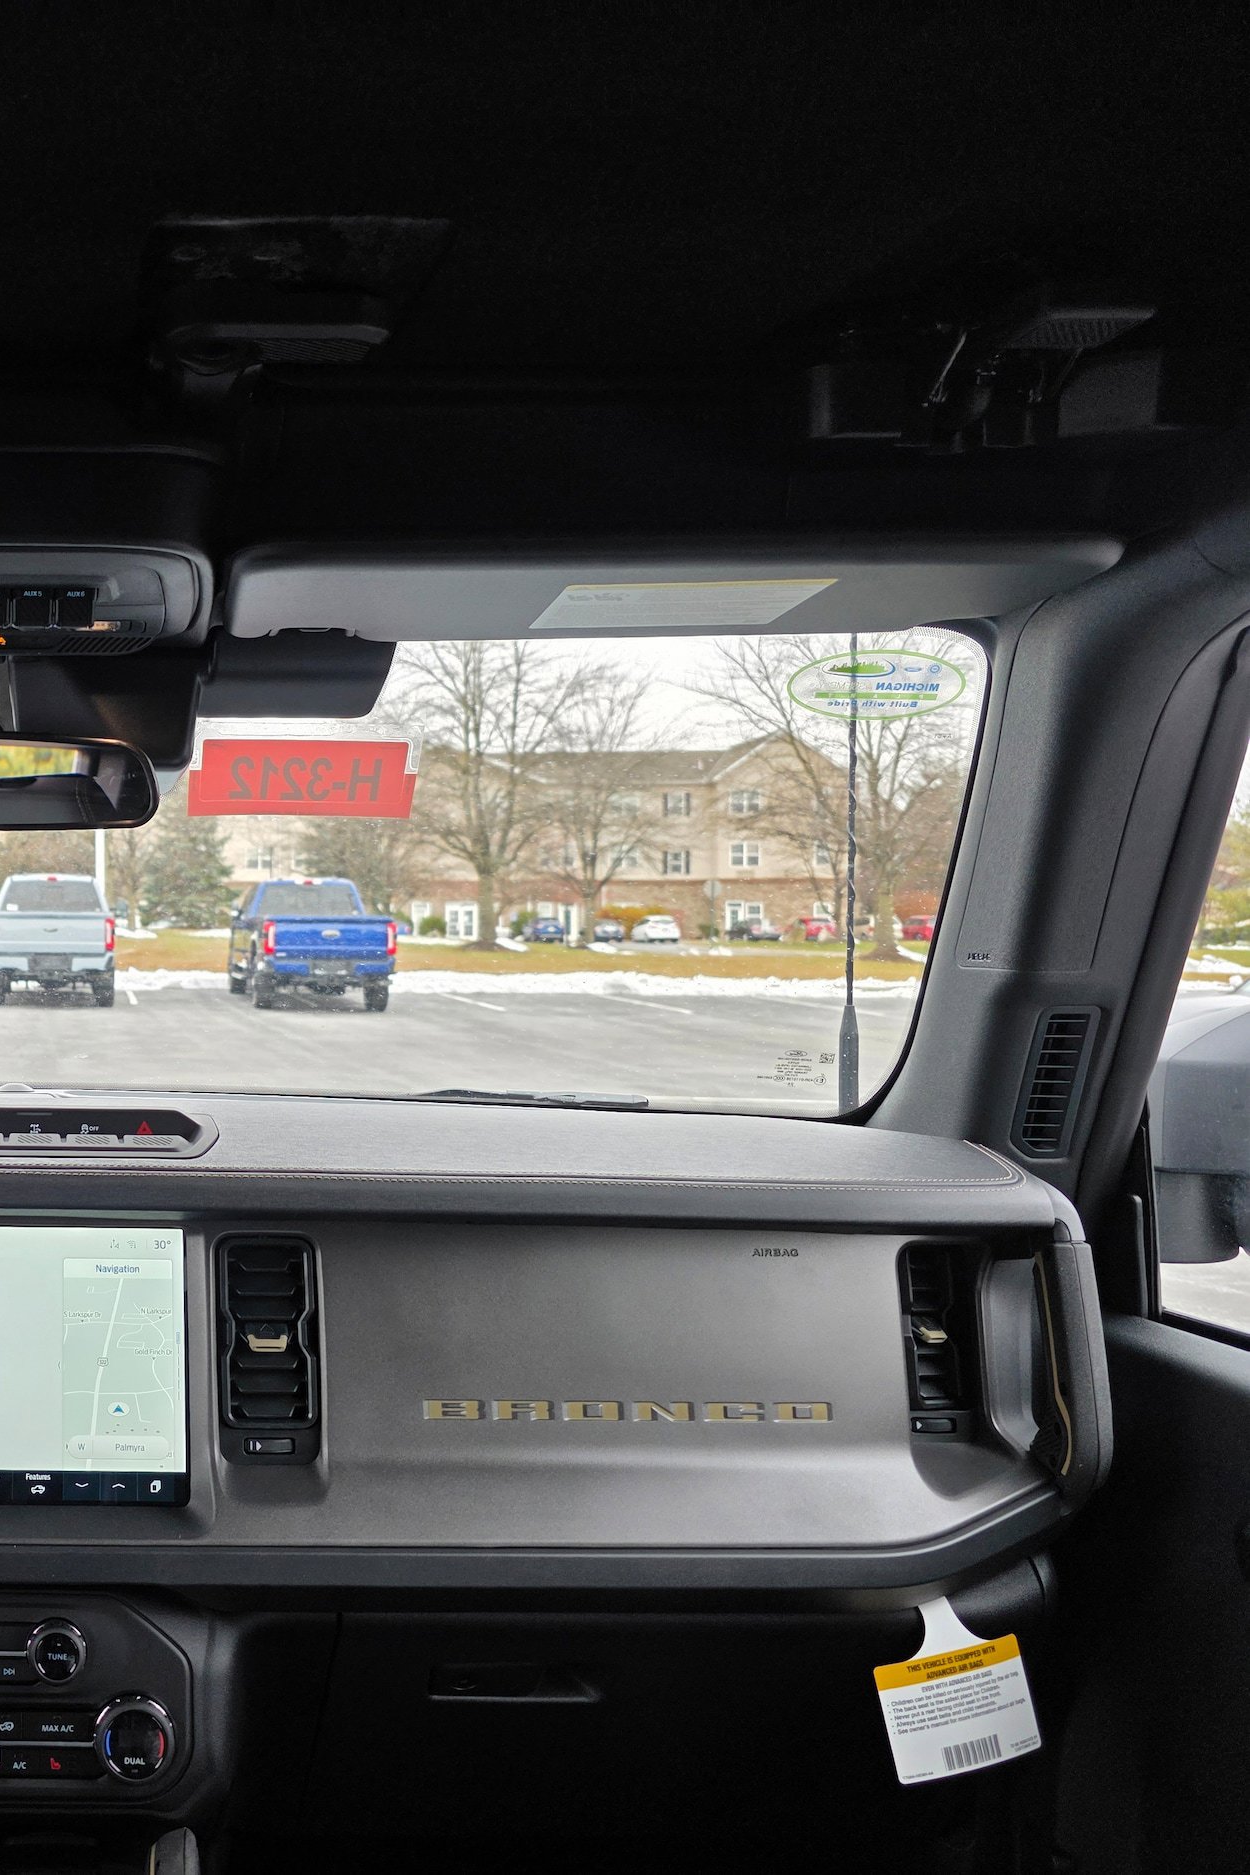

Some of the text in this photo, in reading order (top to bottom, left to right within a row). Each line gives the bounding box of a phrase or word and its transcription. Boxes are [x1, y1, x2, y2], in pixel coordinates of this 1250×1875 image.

[153, 1240, 172, 1250] 30°
[751, 1248, 800, 1258] AIRBAG
[95, 1264, 140, 1274] Navigation
[68, 1311, 94, 1319] Larkspur
[423, 1399, 834, 1422] BRONCO
[115, 1443, 145, 1452] Palmyra
[25, 1472, 51, 1481] Features
[906, 1664, 922, 1673] THIS
[922, 1659, 948, 1670] VEHICLE
[954, 1650, 981, 1663] EQUIPPED
[981, 1645, 996, 1655] WITH
[926, 1659, 984, 1680] ADVANCED AIR BAGS
[921, 1685, 935, 1693] EVEN
[935, 1682, 948, 1690] WITH
[891, 1698, 914, 1707] Children
[933, 1691, 947, 1699] killed
[953, 1684, 974, 1694] seriously
[960, 1692, 973, 1700] place
[894, 1713, 910, 1721] Never
[896, 1720, 916, 1728] Always
[909, 1724, 930, 1733] owner's
[930, 1720, 949, 1729] manual
[41, 1725, 74, 1733] MAX A/C
[12, 1761, 27, 1770] A/C
[124, 1757, 145, 1765] DUAL
